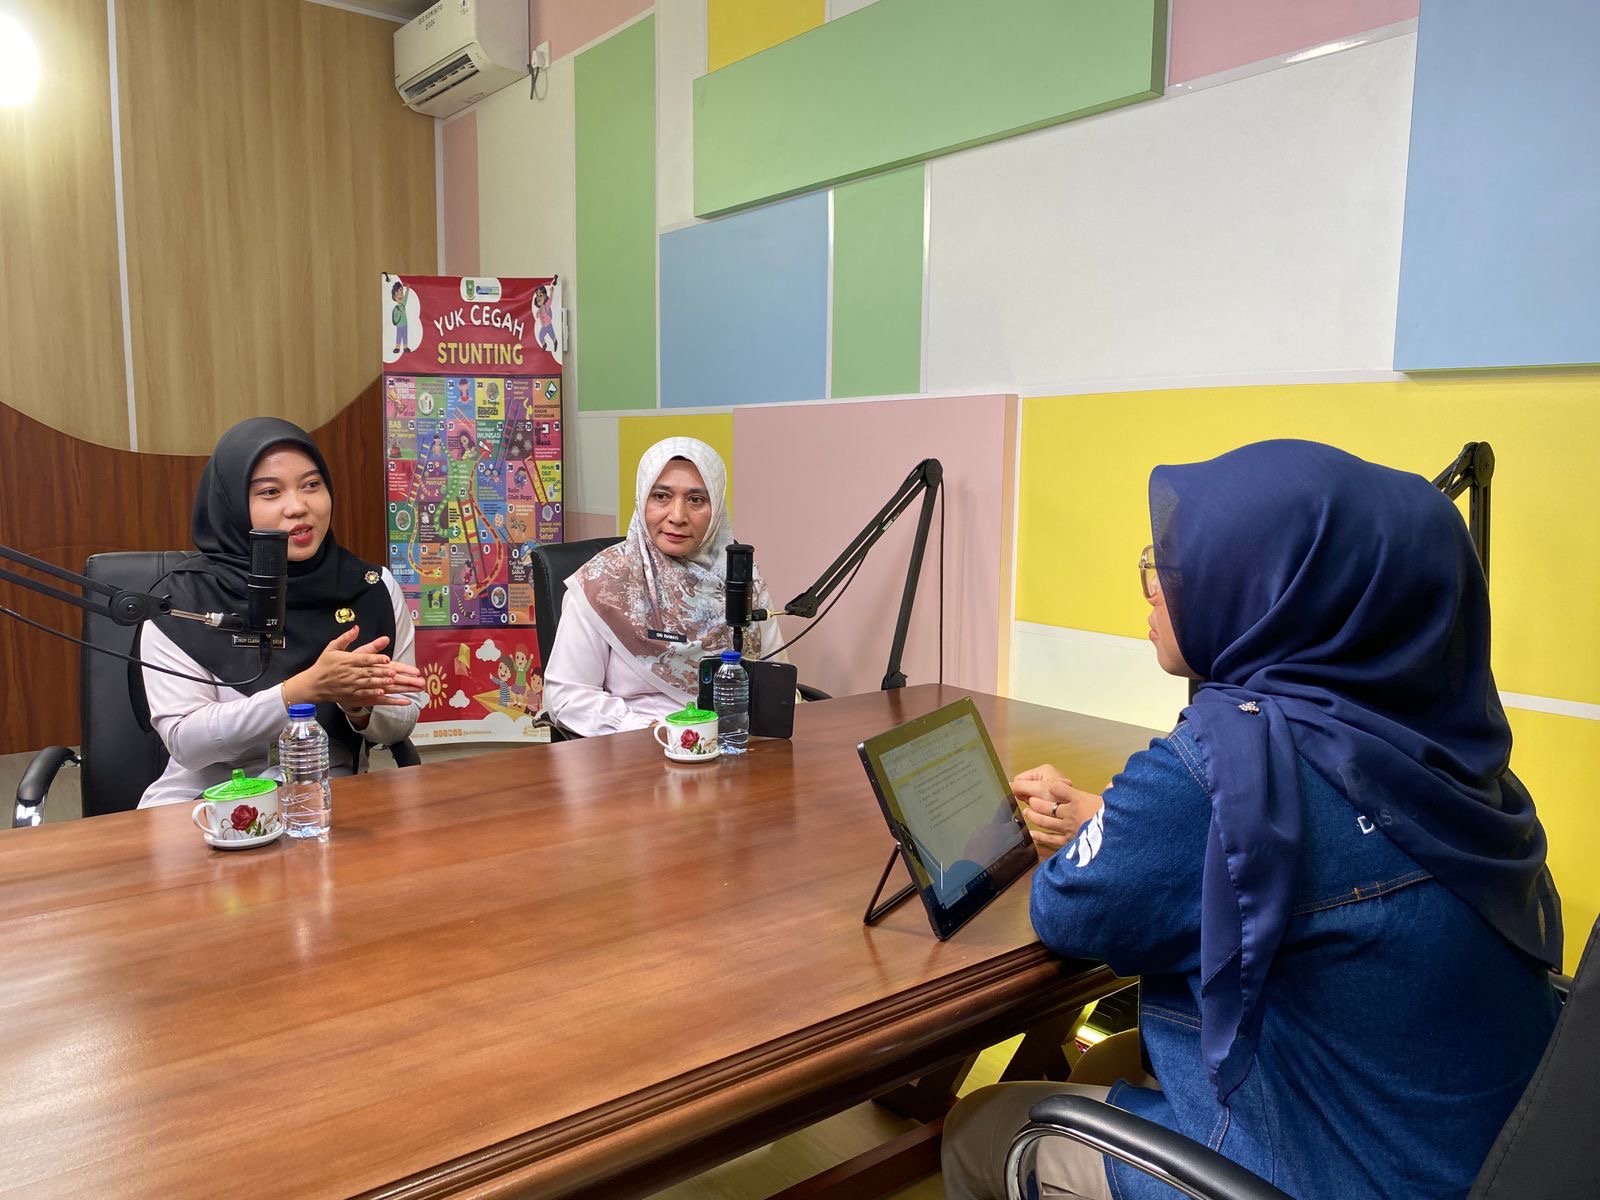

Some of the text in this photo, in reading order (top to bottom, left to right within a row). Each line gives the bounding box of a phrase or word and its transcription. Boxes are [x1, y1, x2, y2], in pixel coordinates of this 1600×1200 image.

[433, 304, 525, 340] YUK CEGAH
[437, 342, 524, 365] STUNTING
